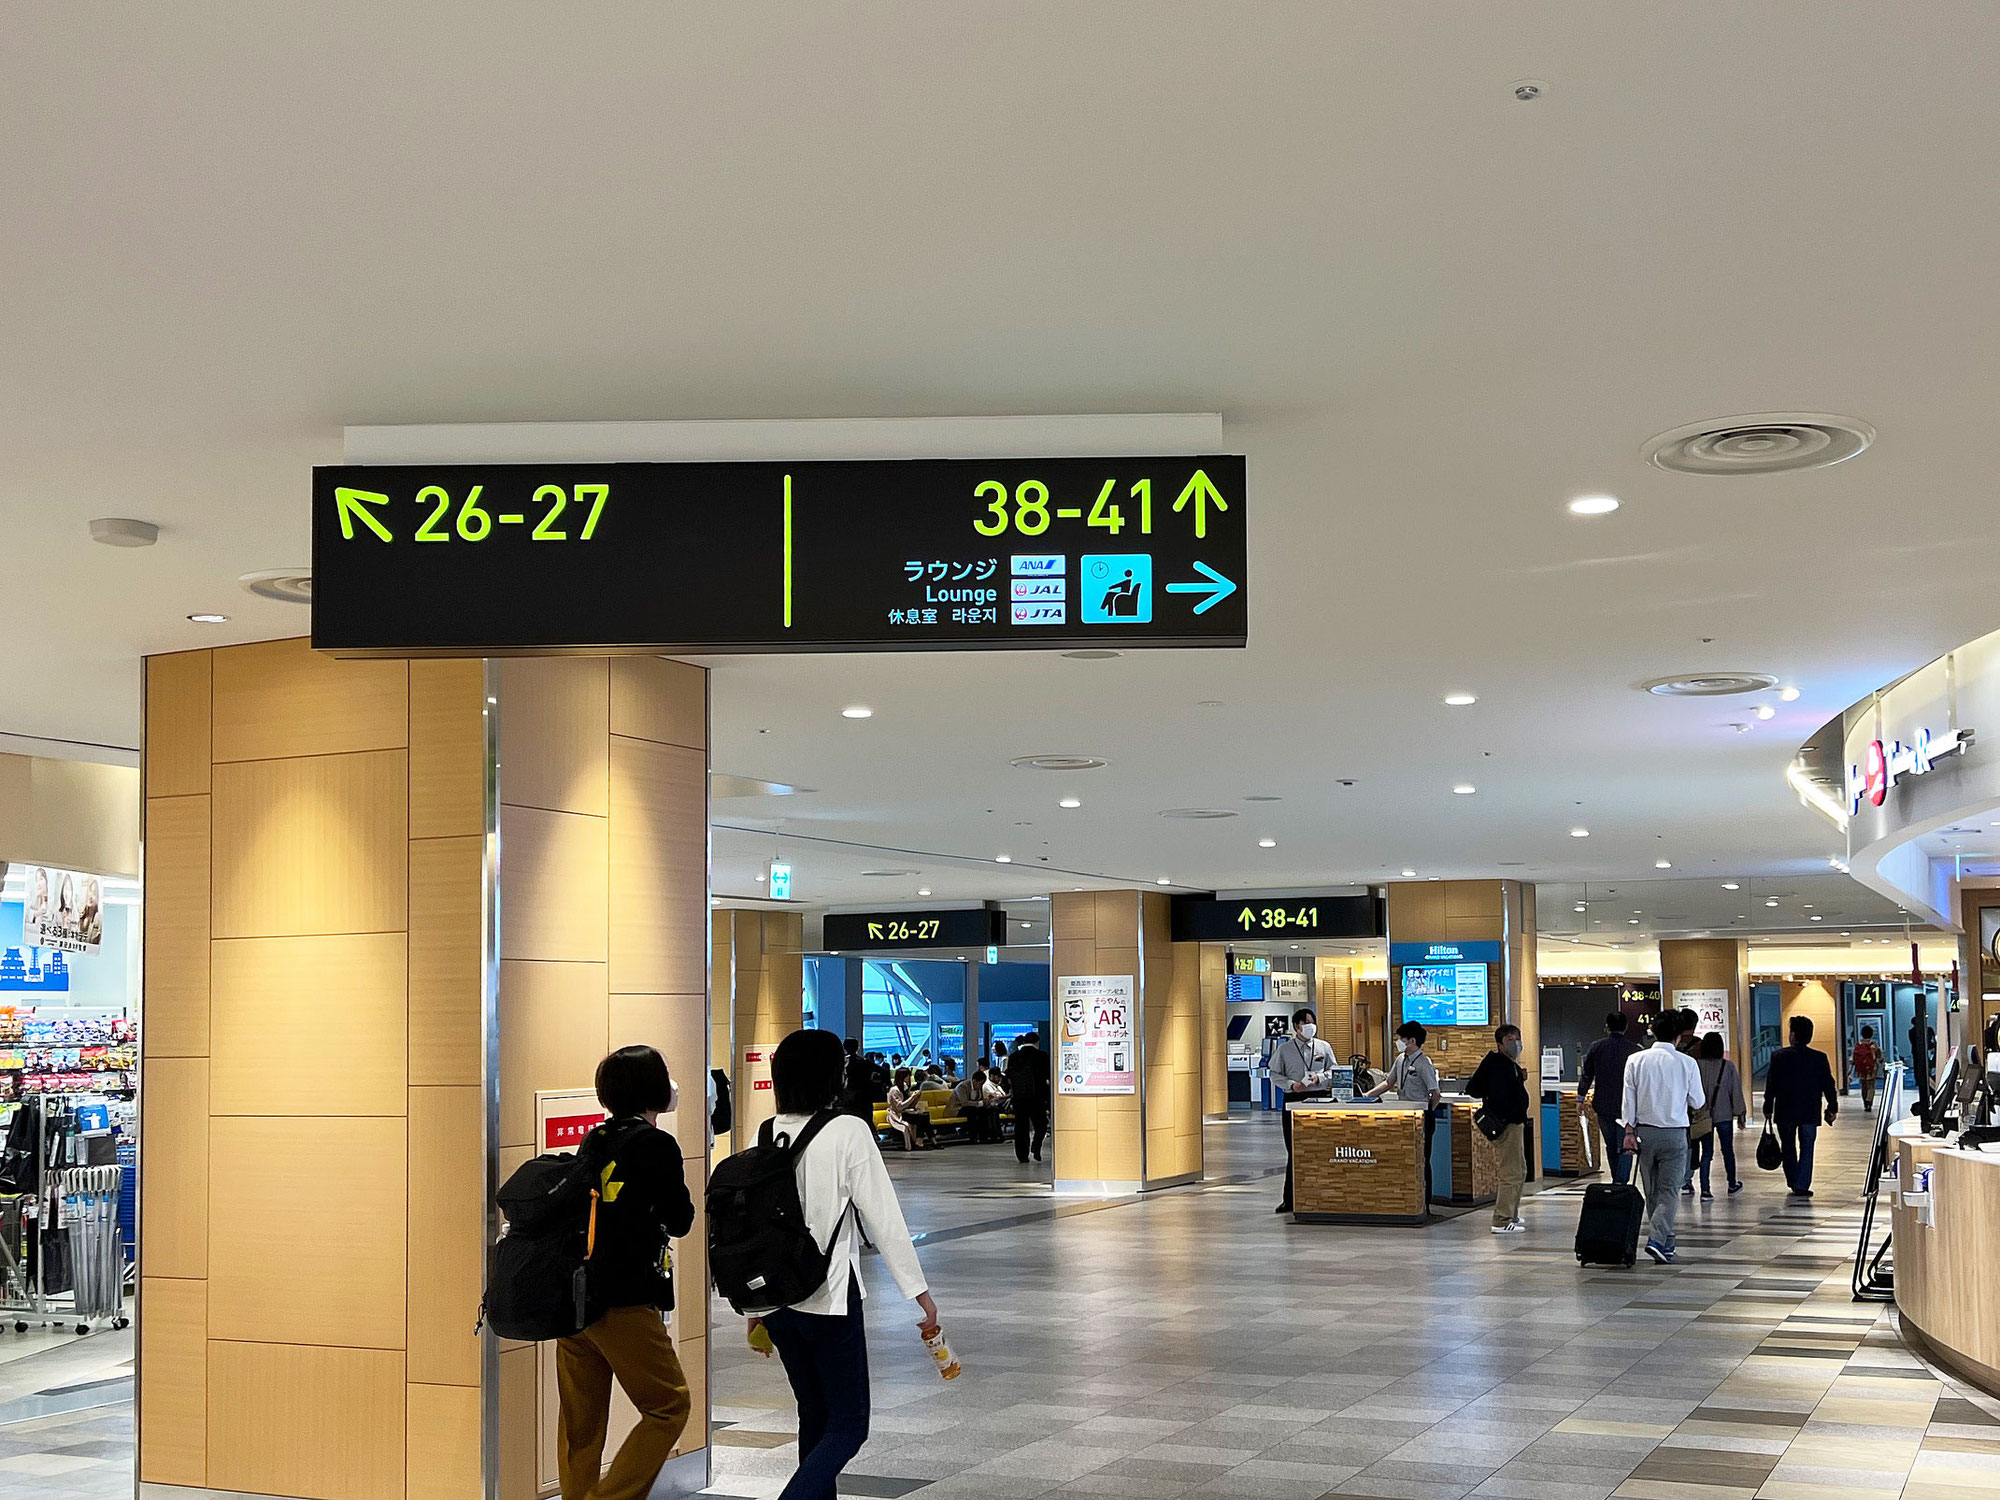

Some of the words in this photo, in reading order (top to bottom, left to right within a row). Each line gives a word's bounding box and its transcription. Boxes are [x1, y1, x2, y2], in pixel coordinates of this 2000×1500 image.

[415, 484, 609, 541] 26-27
[973, 479, 1151, 536] 38-41
[904, 558, 998, 582] ラウンジ
[1019, 560, 1044, 570] ANA
[926, 585, 997, 606] Lounge
[1030, 585, 1062, 595] JAL
[888, 608, 938, 625] 休息室
[952, 607, 997, 624] 라운지
[1030, 608, 1062, 618] JTA
[1261, 907, 1318, 929] 38-41
[888, 920, 940, 940] 26-27
[1429, 945, 1459, 954] Hilton
[1631, 990, 1661, 1001] 38-40
[1860, 986, 1880, 1004] 41
[1098, 1009, 1122, 1025] AR
[1703, 1011, 1721, 1022] AR
[1335, 1146, 1371, 1158] Hilton
